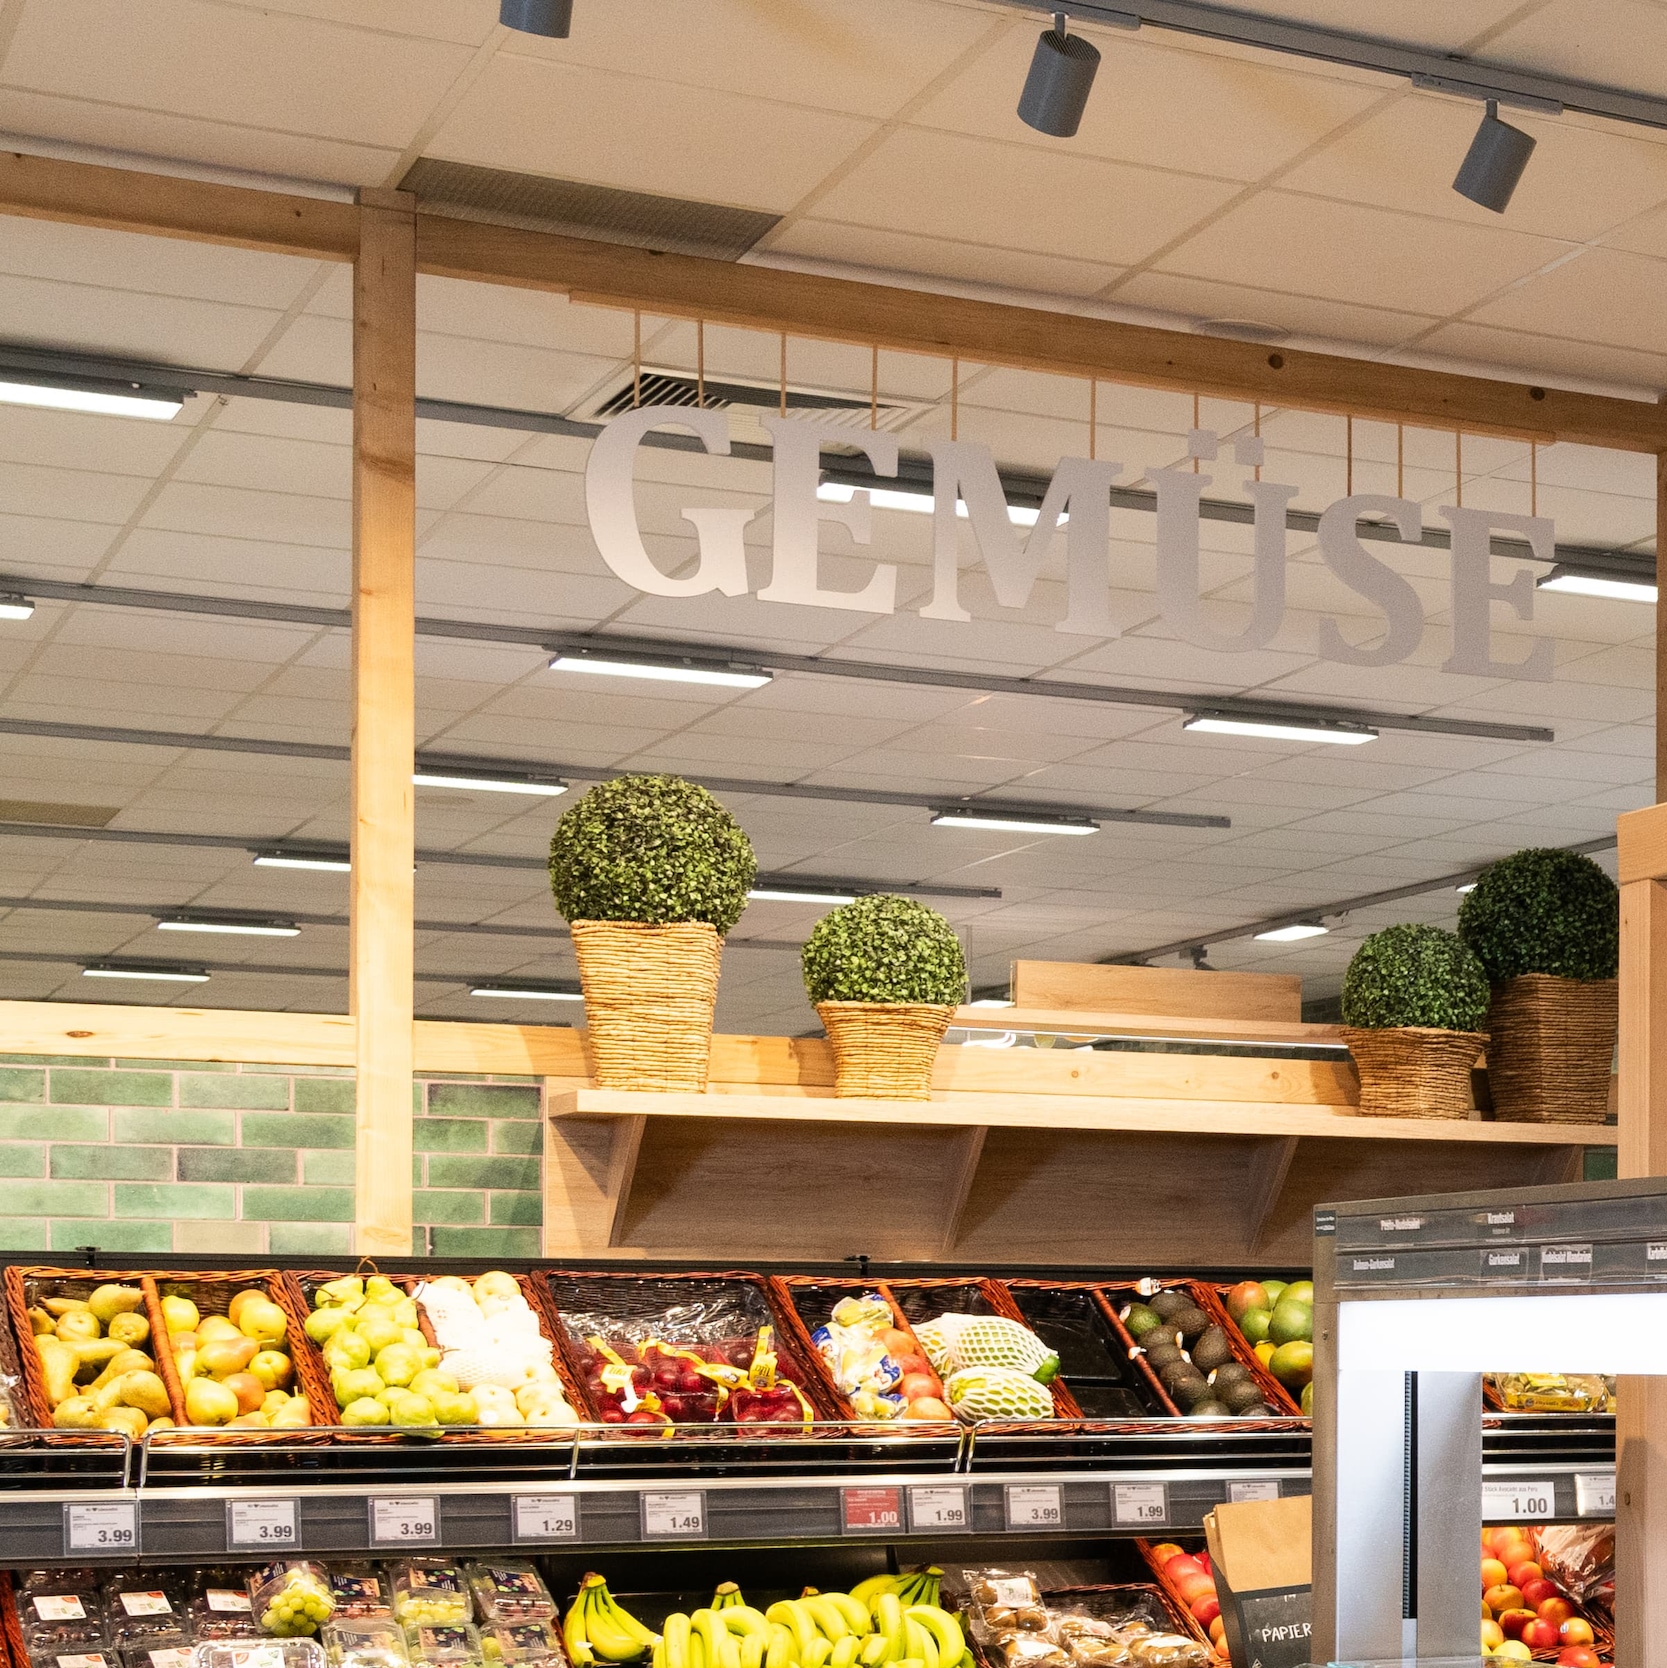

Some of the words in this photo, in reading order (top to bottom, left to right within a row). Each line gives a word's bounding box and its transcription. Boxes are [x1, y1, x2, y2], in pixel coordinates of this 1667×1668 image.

[584, 404, 1554, 684] GEMÜSE
[1137, 1505, 1164, 1518] 1.99
[1512, 1496, 1548, 1514] 1.00
[868, 1510, 899, 1525] 1.00
[935, 1509, 963, 1522] 1.99
[1031, 1507, 1060, 1521] 3.99
[542, 1519, 574, 1533] 1.29
[670, 1515, 700, 1529] 1.49
[98, 1529, 132, 1542] 3.99
[259, 1525, 293, 1538] 3.99
[400, 1522, 433, 1537] 3.99
[1262, 1623, 1313, 1642] PAPIER
